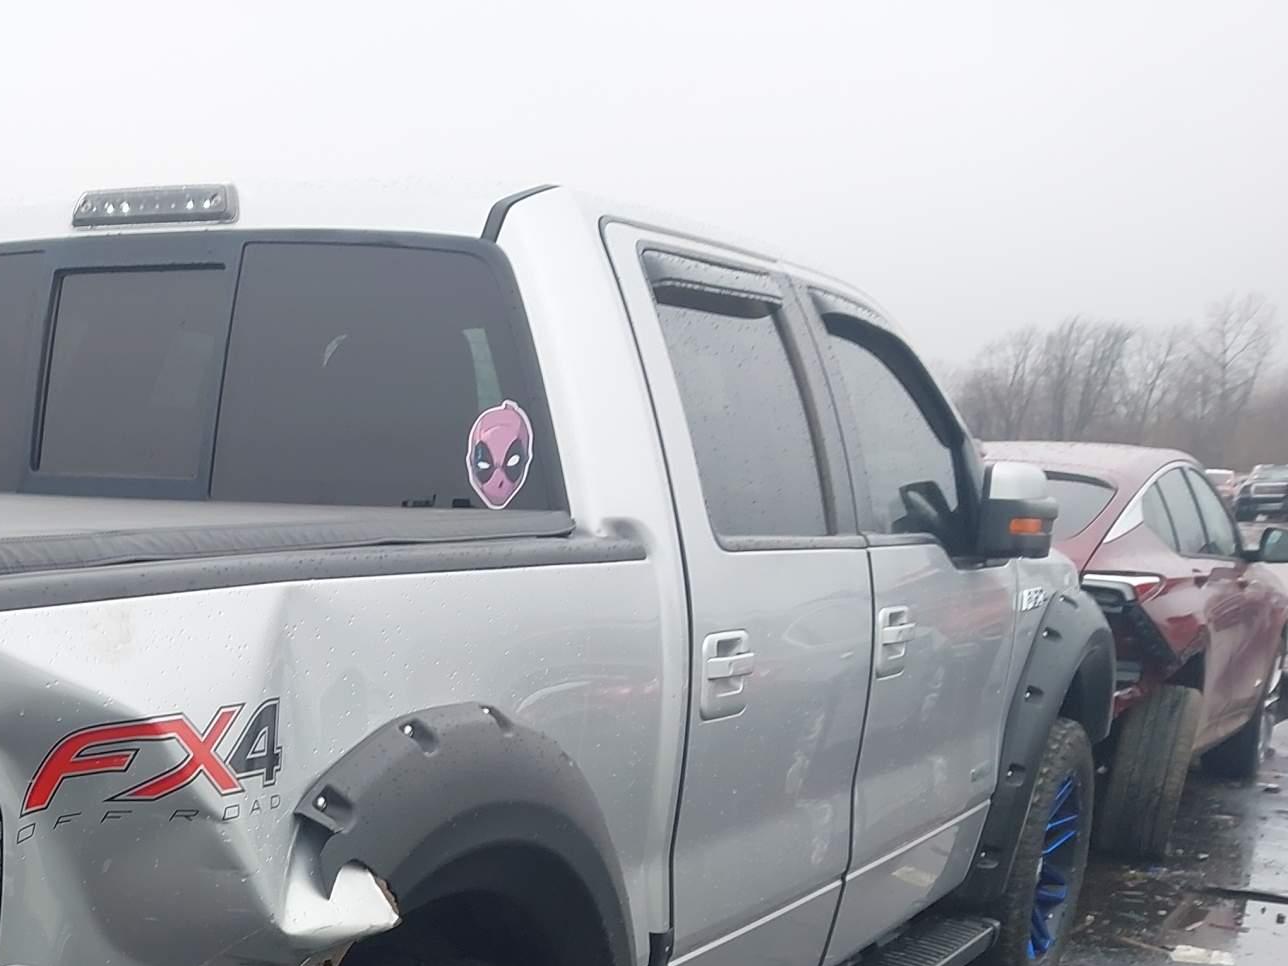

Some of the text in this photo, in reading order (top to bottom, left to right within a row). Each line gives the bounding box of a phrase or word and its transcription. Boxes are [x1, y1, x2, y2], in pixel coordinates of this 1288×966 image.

[19, 697, 283, 819] FX4
[16, 794, 281, 844] OFF ROAD
